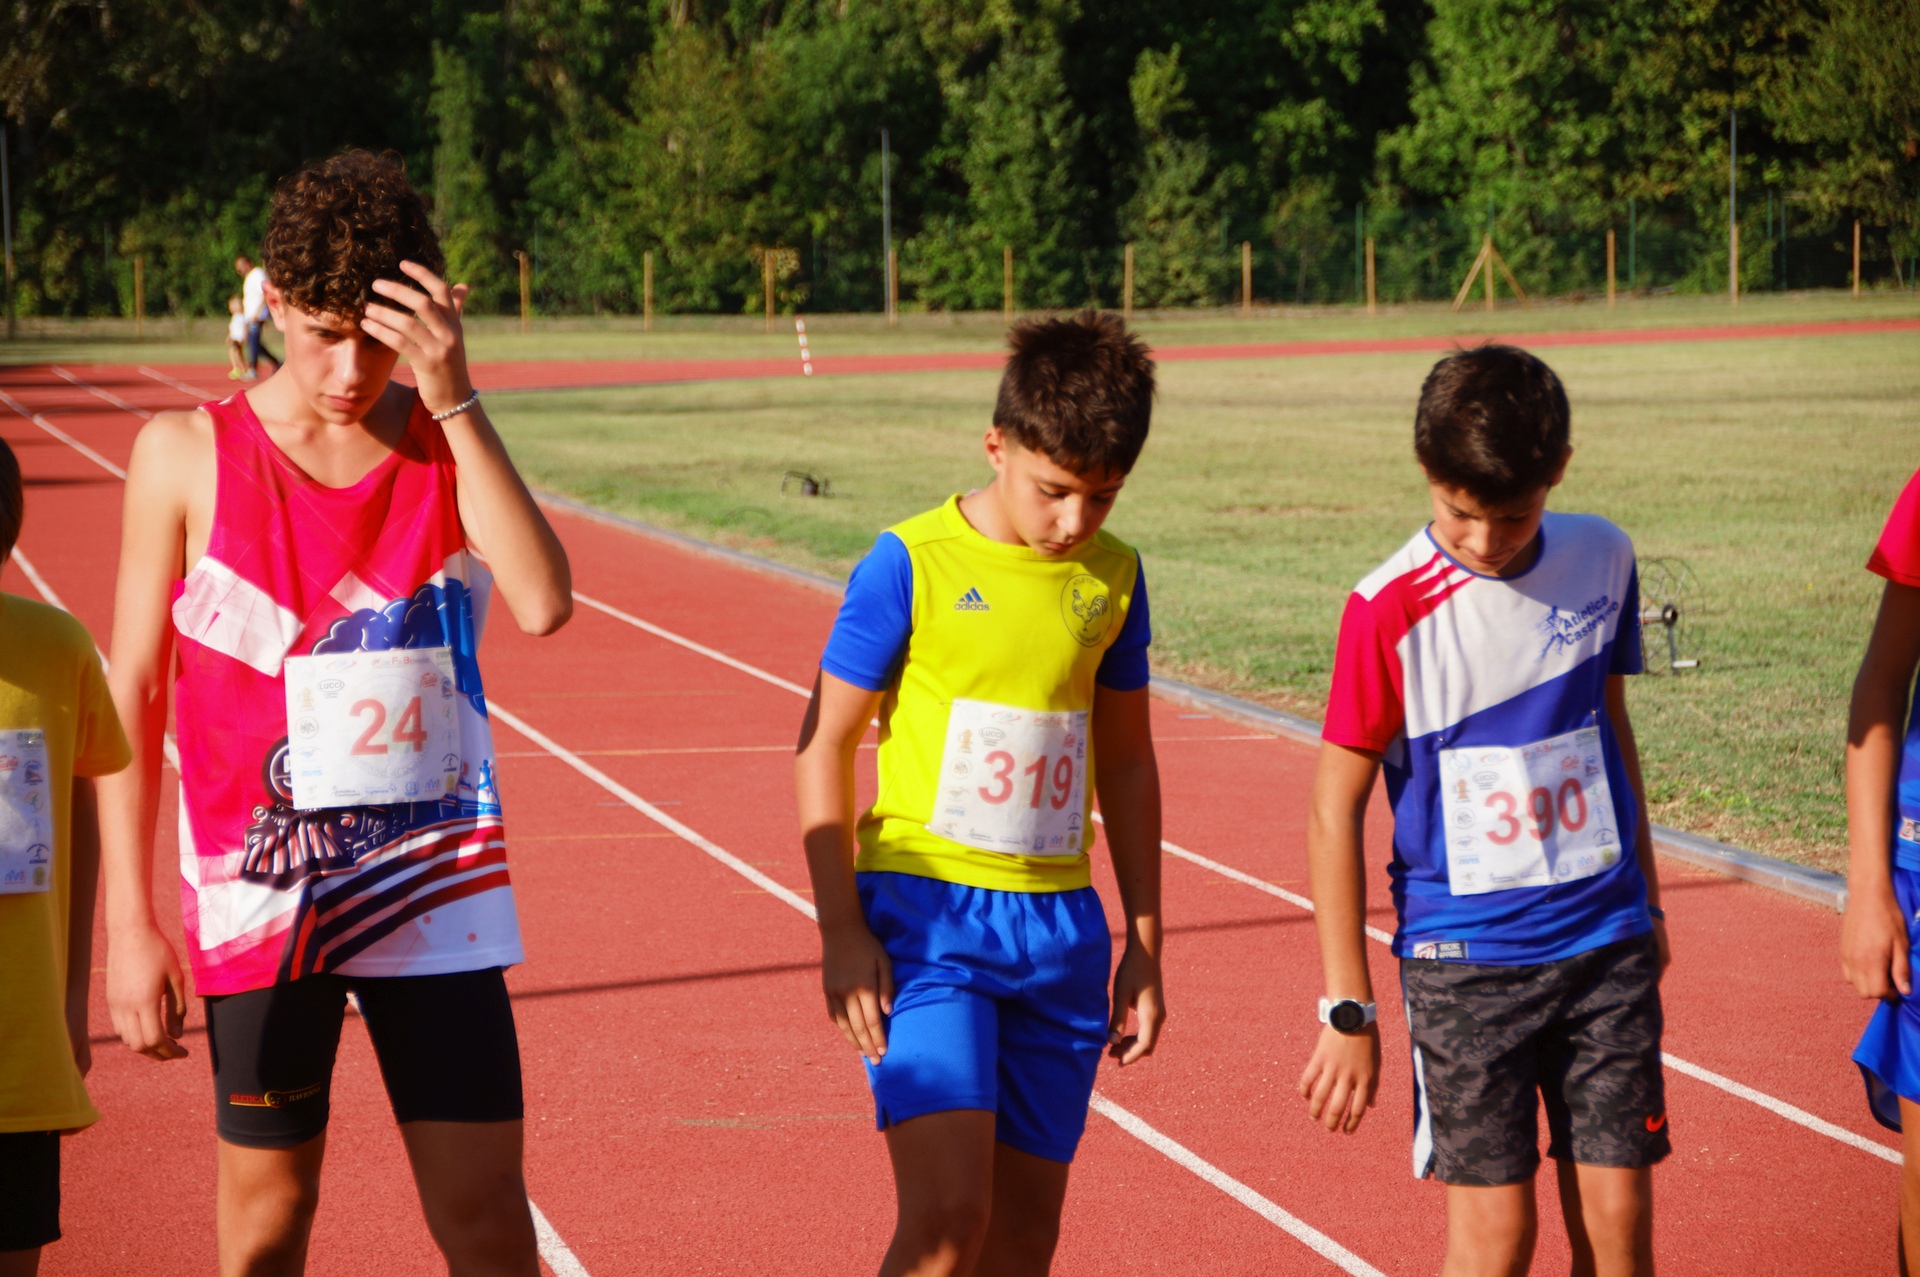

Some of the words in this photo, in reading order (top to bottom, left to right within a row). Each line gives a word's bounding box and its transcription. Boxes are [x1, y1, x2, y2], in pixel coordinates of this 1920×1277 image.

[954, 601, 990, 611] adidas
[1563, 595, 1609, 632] Atletica
[319, 681, 343, 691] LUCCI
[349, 696, 428, 756] 24
[977, 750, 1073, 810] 319
[1485, 777, 1588, 846] 390
